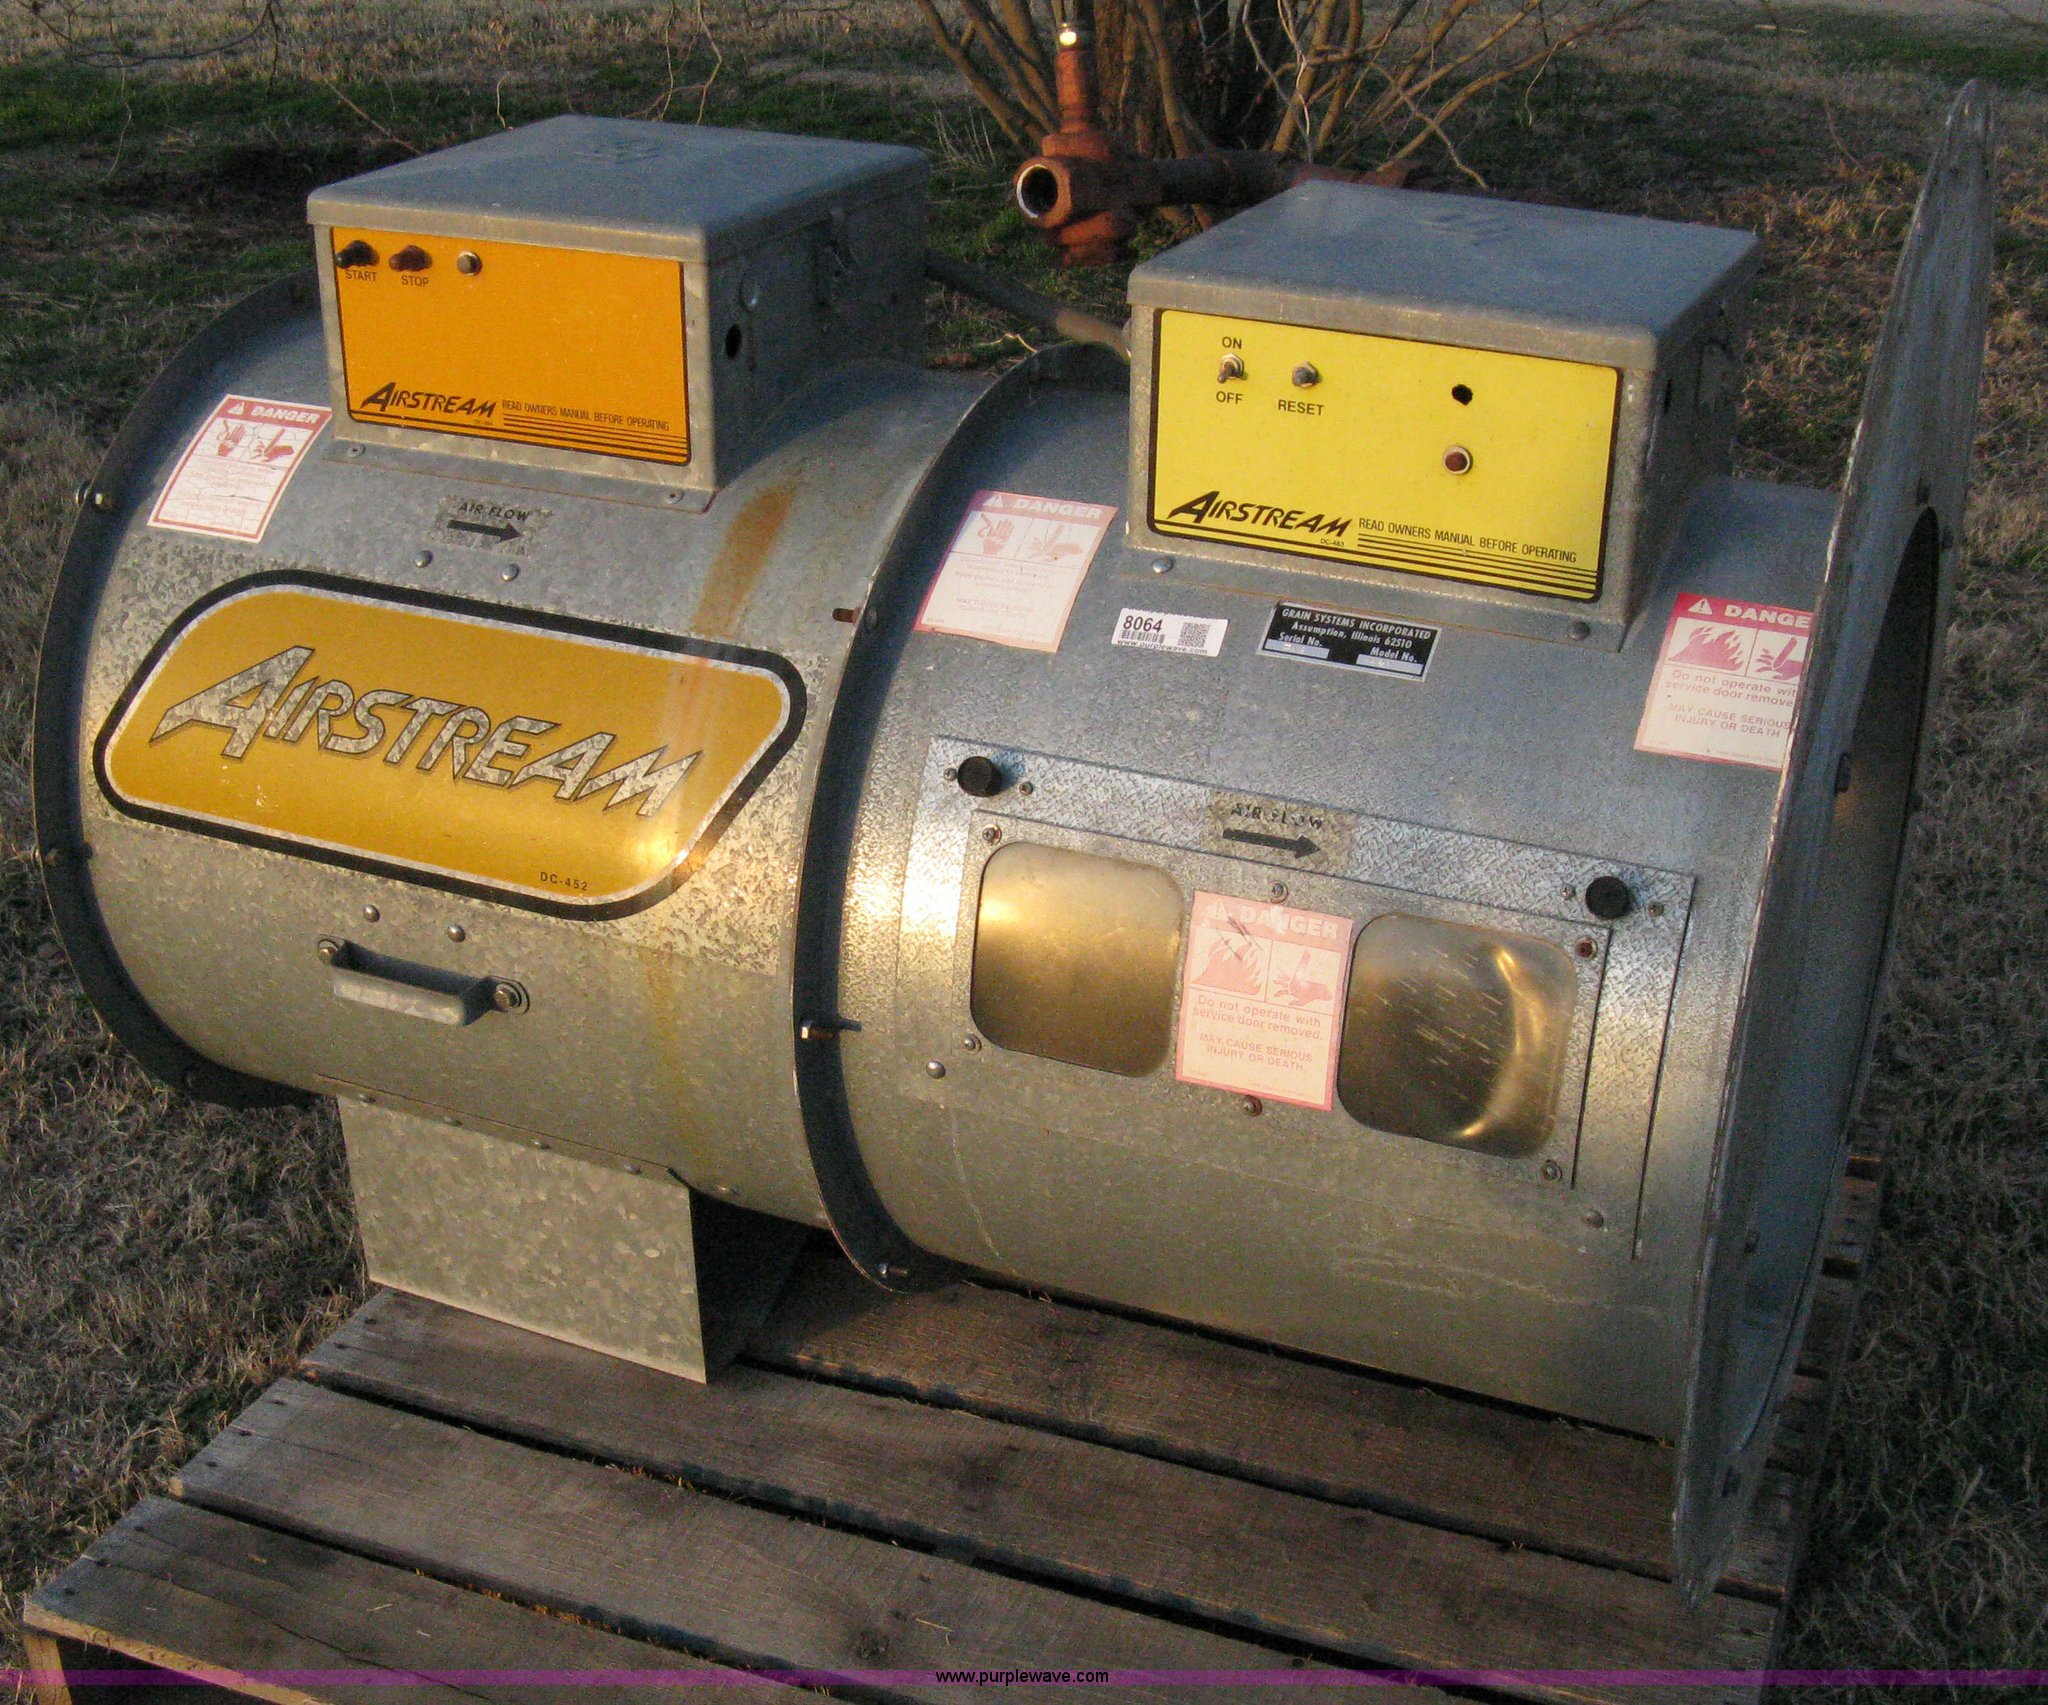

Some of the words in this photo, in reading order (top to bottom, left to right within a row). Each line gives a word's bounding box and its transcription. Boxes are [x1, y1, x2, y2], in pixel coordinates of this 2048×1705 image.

[345, 269, 377, 282] START
[401, 274, 429, 287] STOP
[1221, 336, 1243, 349] ON
[360, 381, 497, 418] AIRSTREAM
[1216, 390, 1243, 404] OFF
[1277, 399, 1325, 416] RESET
[251, 406, 320, 424] DANGER
[501, 400, 522, 411] READ
[524, 402, 558, 416] OWNERS
[559, 408, 592, 421] MANUAL
[594, 412, 624, 425] BEFORE
[626, 416, 670, 432] OPERATING
[458, 501, 484, 514] AIR
[488, 506, 530, 522] FLOW
[1015, 499, 1103, 518] DANGER
[1167, 490, 1353, 538] AIRSTREAM
[1359, 517, 1385, 532] READ
[1388, 521, 1431, 539] OWNERS
[1434, 529, 1475, 547] MANUAL
[1479, 536, 1518, 553] BEFORE
[1521, 543, 1577, 563] OPERATING
[1122, 615, 1163, 633] 8064
[1281, 607, 1312, 621] GRAIN
[1314, 613, 1355, 628] SYSTEMS
[1359, 620, 1431, 640] INCORPORATED
[1724, 604, 1812, 629] DANGE
[1279, 631, 1305, 644] Serial
[1307, 636, 1323, 647] No.
[1291, 621, 1347, 639] Assumption,
[1351, 631, 1381, 644] Illinois
[1384, 636, 1412, 649] 62510
[1369, 646, 1400, 660] Model
[1401, 651, 1418, 663] No.
[1665, 681, 1711, 693] service
[1713, 686, 1744, 699] door
[1745, 693, 1794, 708] remove
[1671, 669, 1690, 680] Do
[1695, 674, 1716, 684] not
[1721, 679, 1772, 693] operate
[1777, 686, 1797, 698] wit
[1674, 714, 1718, 727] INJURY
[1720, 721, 1737, 731] OR
[1740, 724, 1780, 738] DEATH
[1697, 707, 1738, 721] CAUSE
[1741, 714, 1791, 730] SERIOUS
[148, 644, 705, 819] AIRSTREAM
[540, 871, 588, 891] DC-452
[1198, 994, 1214, 1007] Do
[1219, 998, 1239, 1011] not
[1244, 1006, 1290, 1023] operate
[1295, 1014, 1322, 1028] with
[1192, 1007, 1234, 1023] service
[1237, 1013, 1266, 1029] door
[1268, 1022, 1324, 1041] removed.
[1206, 1044, 1244, 1060] INJURY
[1248, 1052, 1264, 1063] OR
[1226, 1038, 1264, 1053] CAUSE
[1266, 1045, 1313, 1063] SERIOUS
